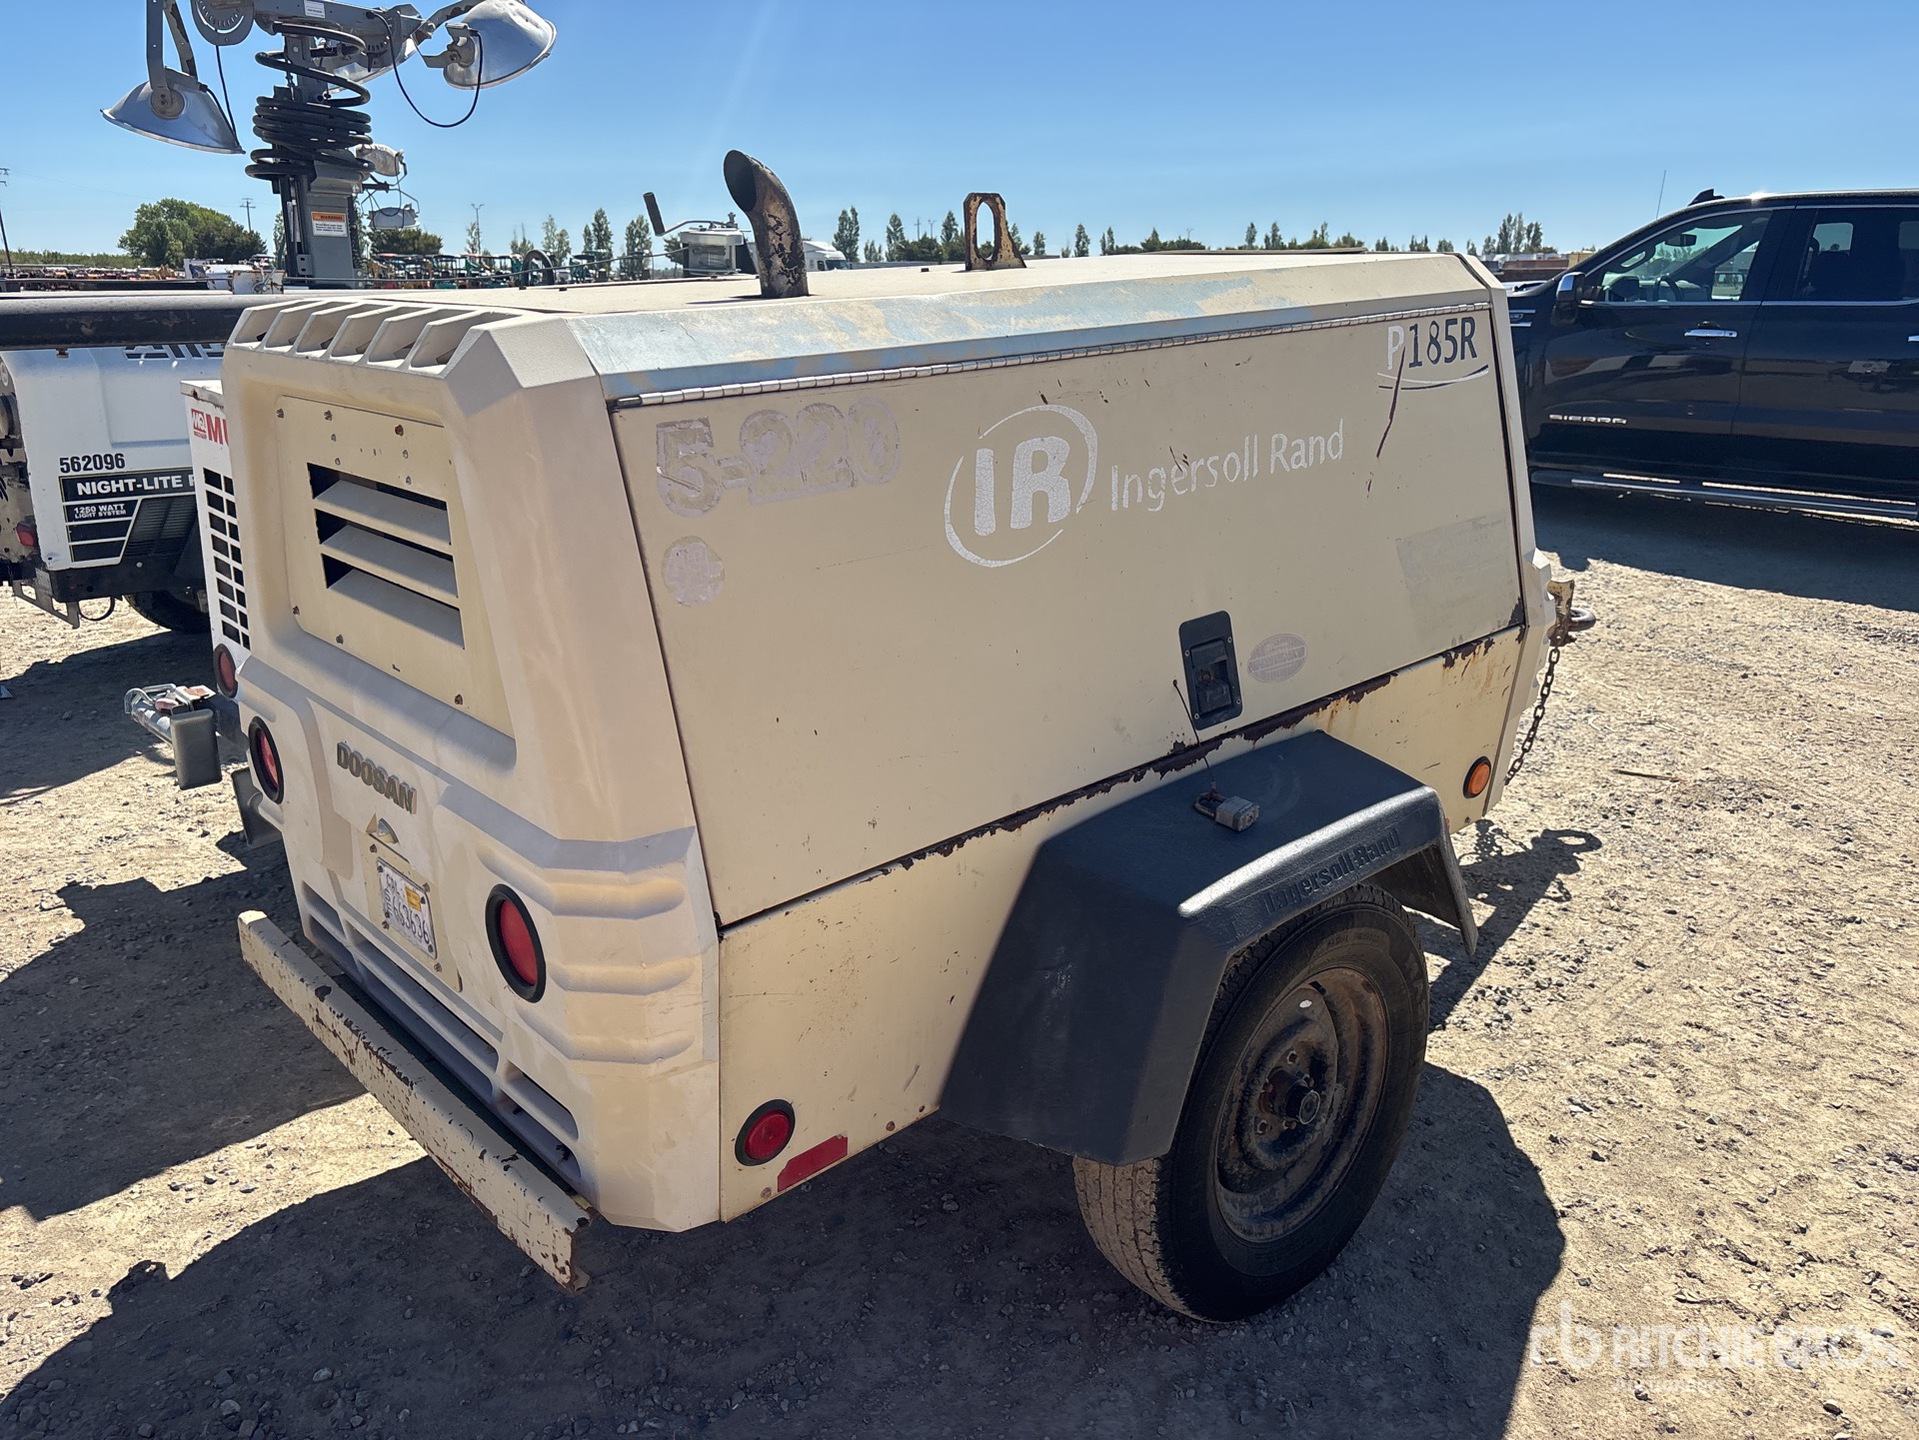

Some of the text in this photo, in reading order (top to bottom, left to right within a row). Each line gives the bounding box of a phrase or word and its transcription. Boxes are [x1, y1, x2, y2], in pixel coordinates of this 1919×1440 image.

[1387, 316, 1478, 371] P185R
[1549, 414, 1627, 424] SIERRA
[59, 453, 126, 473] 562096
[1109, 418, 1345, 513] Ingersoll Rand
[77, 475, 183, 496] NIGHT-LITE
[973, 436, 1072, 536] IR
[74, 503, 125, 514] 1250 WATT
[74, 511, 96, 519] LIGHT
[337, 741, 418, 815] DOOSAN
